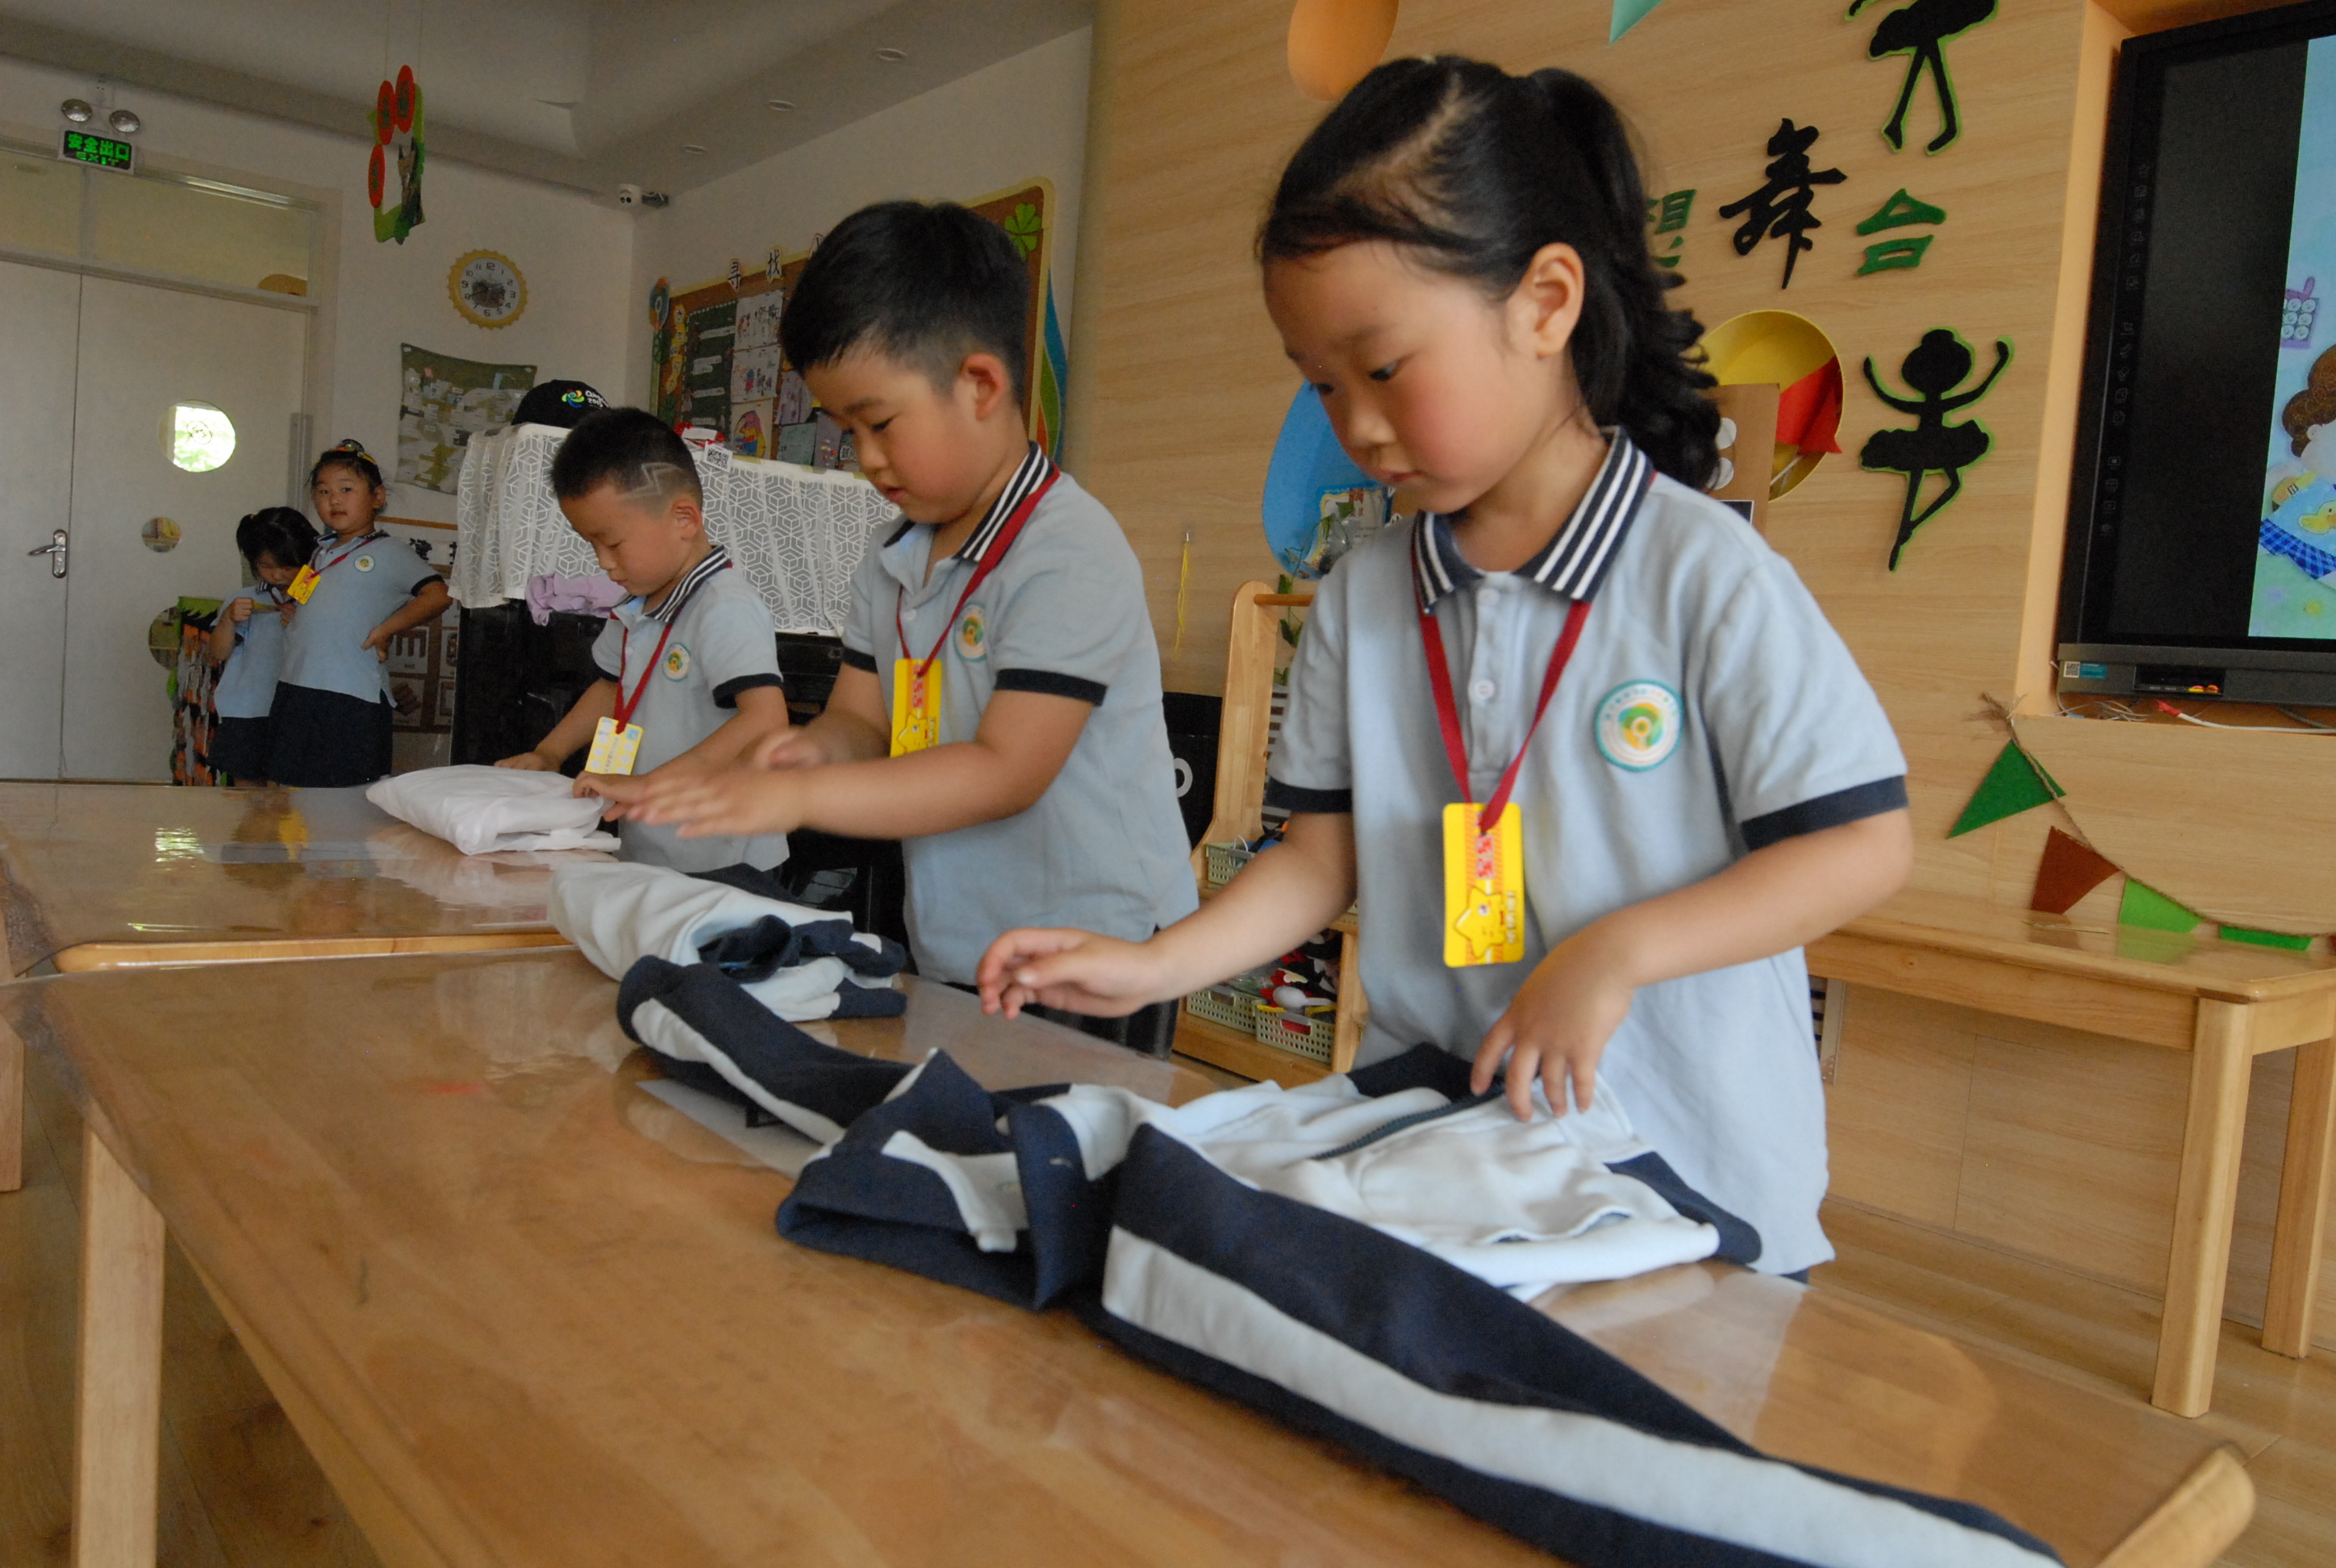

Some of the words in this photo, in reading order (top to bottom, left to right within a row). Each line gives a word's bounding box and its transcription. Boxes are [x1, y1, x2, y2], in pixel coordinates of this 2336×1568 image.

[68, 133, 129, 161] 安全出口
[77, 151, 119, 165] EXIT
[486, 262, 495, 271] 12
[465, 269, 473, 277] 10
[461, 280, 469, 289] 9
[507, 278, 514, 286] 2
[510, 290, 516, 298] 3
[483, 309, 491, 317] 6
[496, 307, 503, 315] 5
